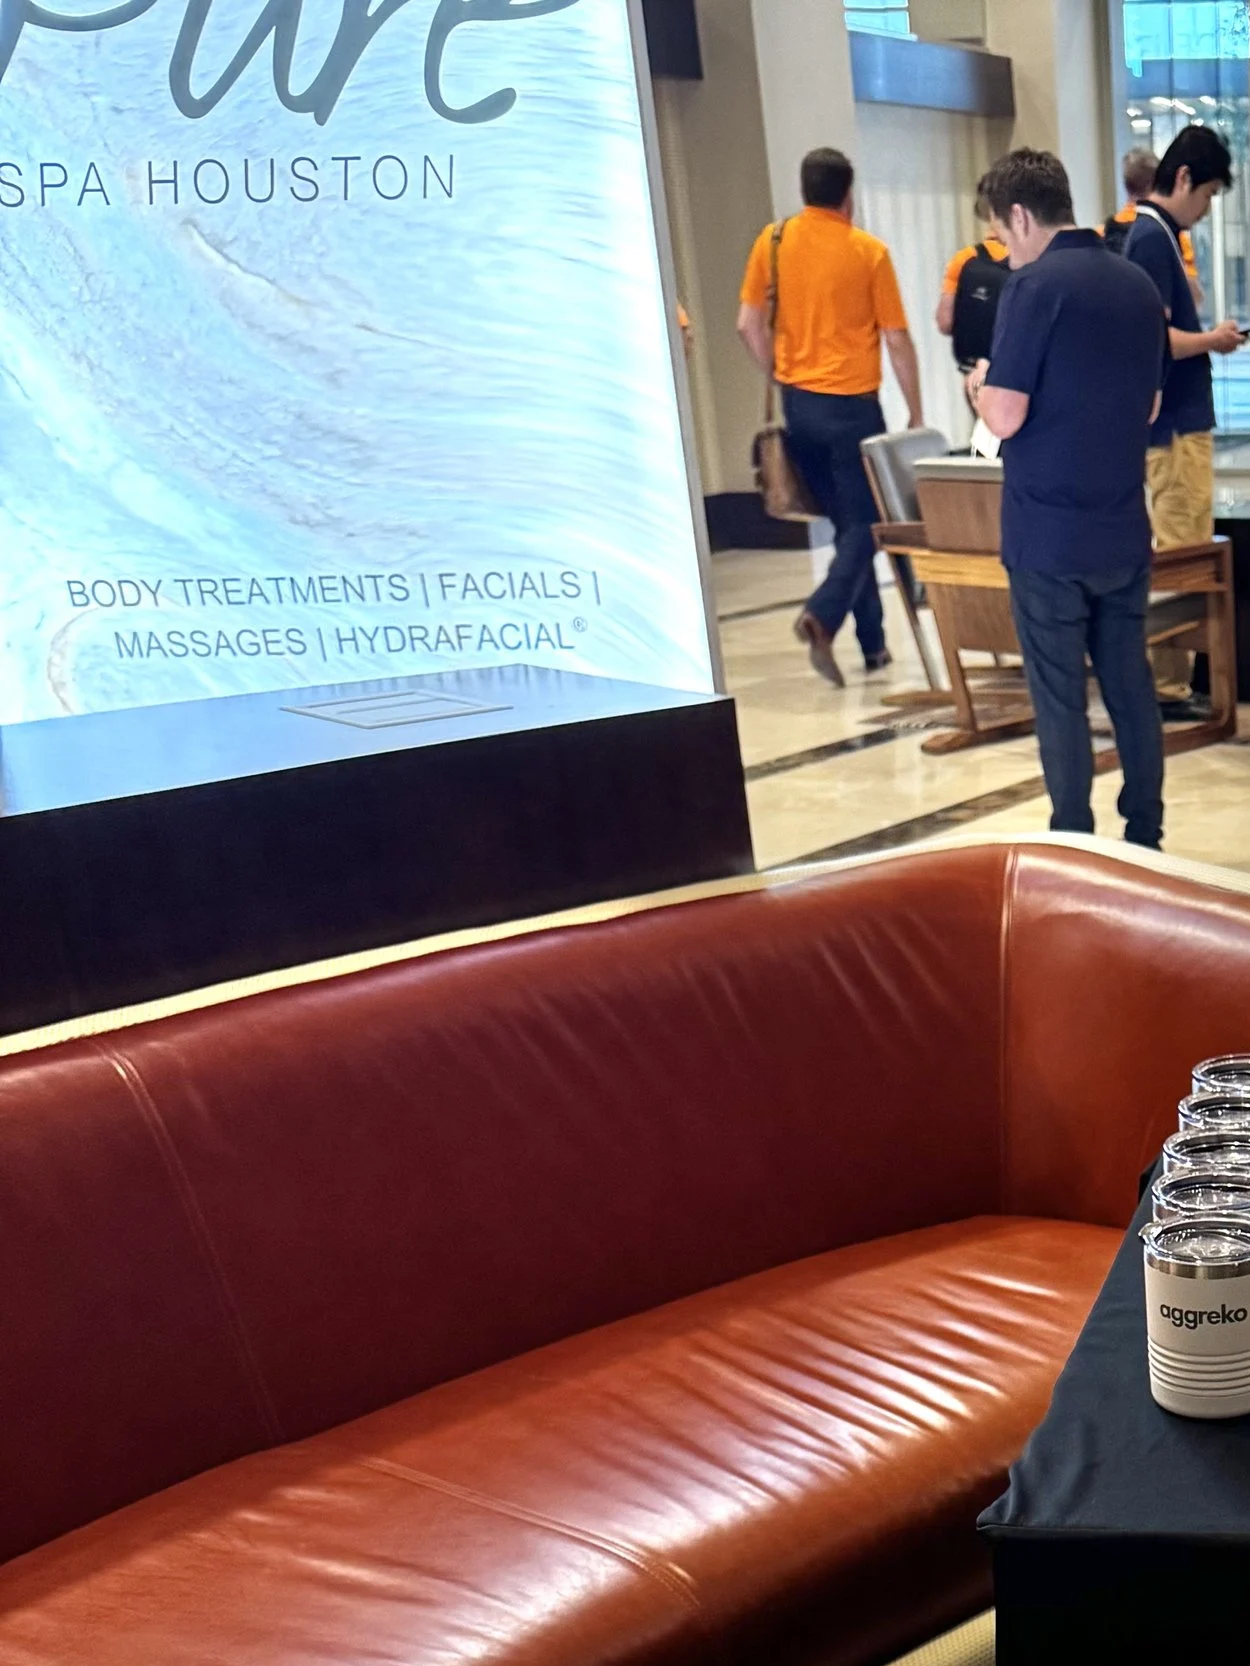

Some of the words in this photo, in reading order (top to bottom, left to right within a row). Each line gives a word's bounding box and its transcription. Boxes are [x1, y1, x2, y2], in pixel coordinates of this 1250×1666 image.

[0, 161, 110, 207] SPA
[147, 154, 454, 205] HOUSTON
[66, 579, 163, 608] BODY
[173, 573, 411, 607] TREATMENTS
[439, 571, 582, 602] FACIALS
[115, 627, 306, 659] MASSAGES
[1160, 1304, 1248, 1329] aggreko
